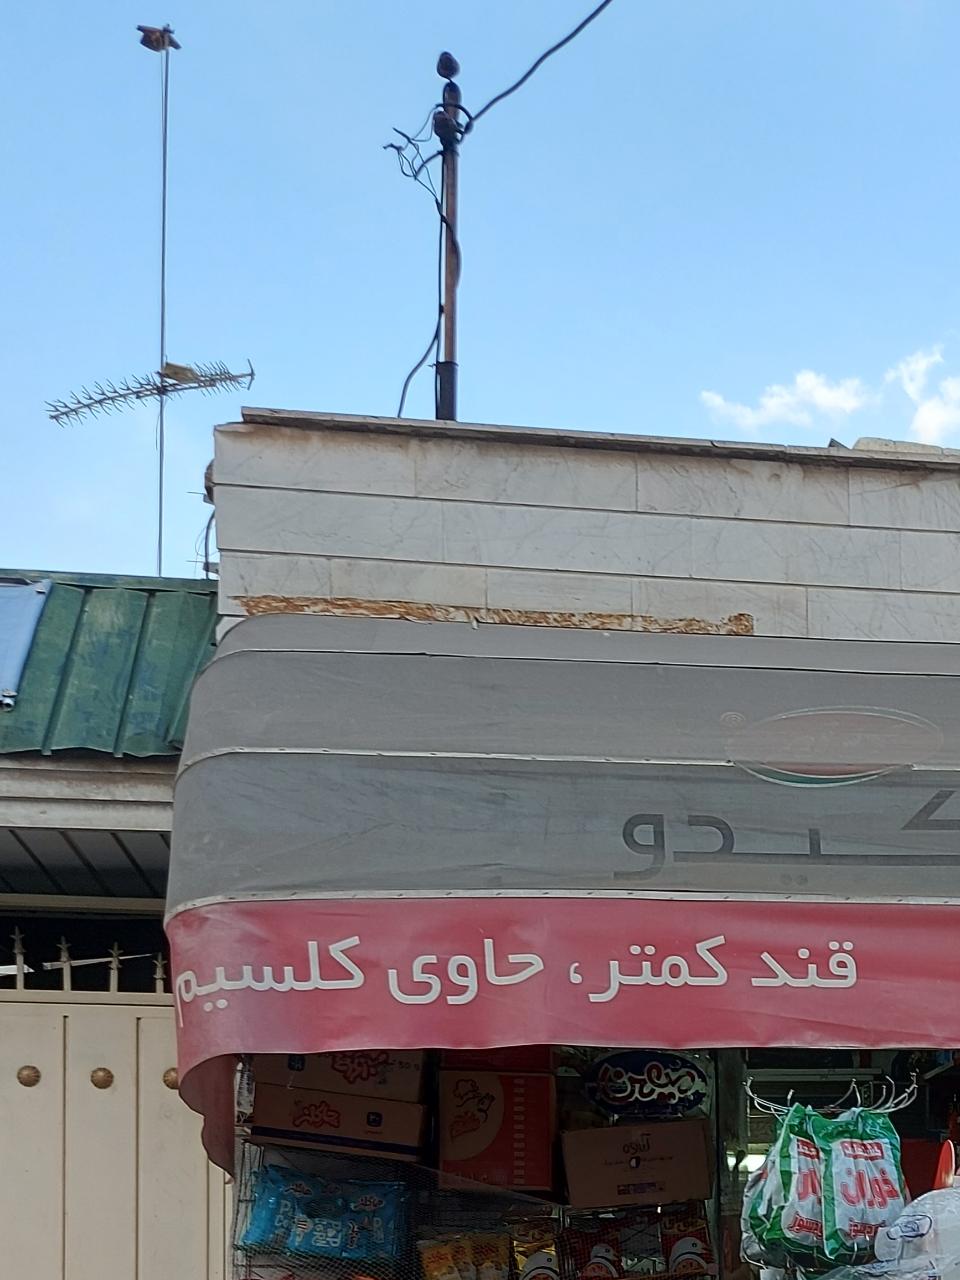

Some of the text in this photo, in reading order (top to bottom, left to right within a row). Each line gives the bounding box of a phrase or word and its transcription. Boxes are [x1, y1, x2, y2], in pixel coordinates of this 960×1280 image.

[175, 935, 367, 1028] کلسیم
[388, 937, 545, 1005] حاوی
[568, 935, 728, 1003] کمتر،
[751, 940, 857, 990] قند
